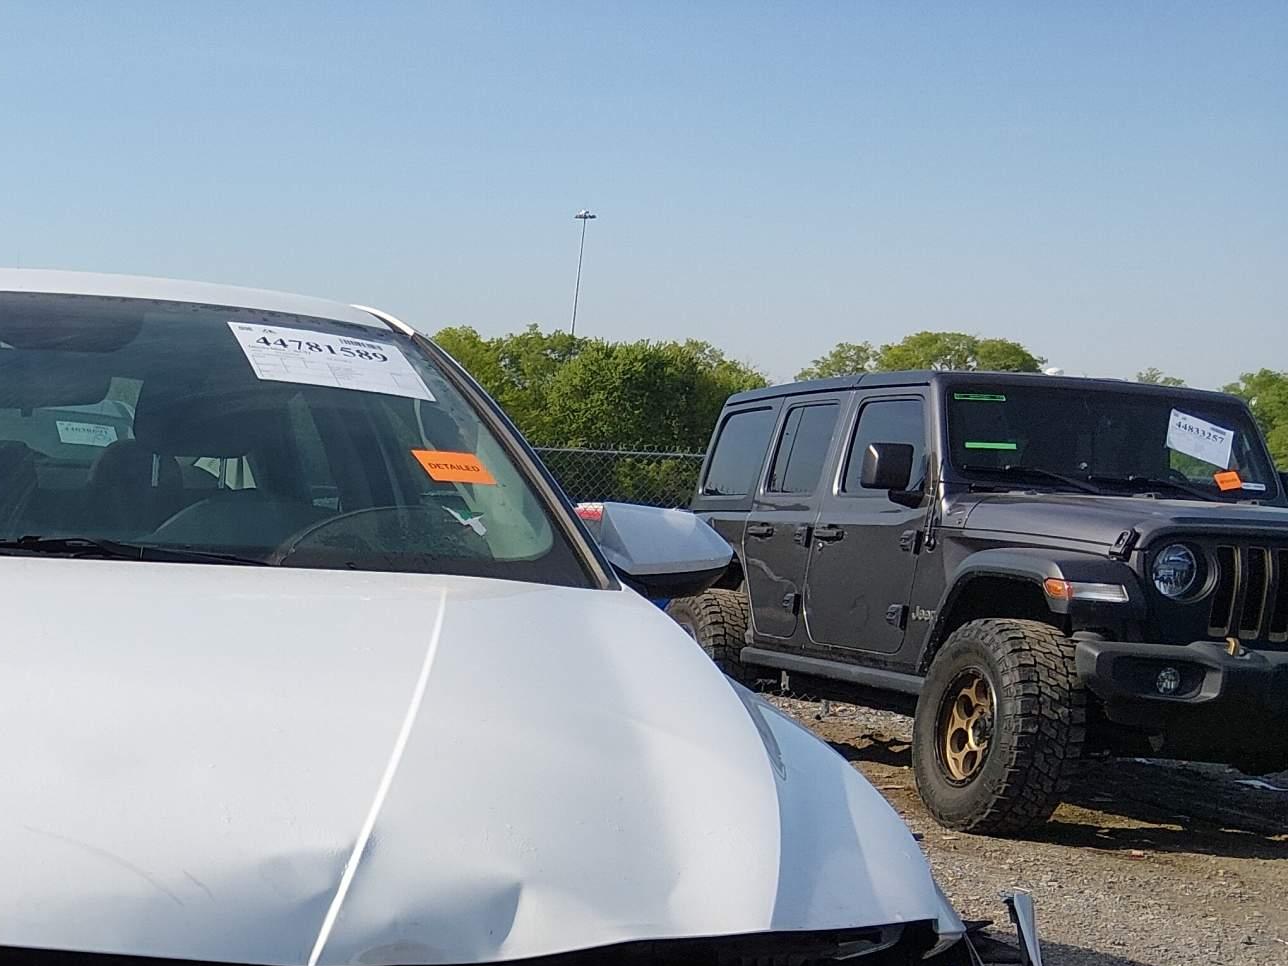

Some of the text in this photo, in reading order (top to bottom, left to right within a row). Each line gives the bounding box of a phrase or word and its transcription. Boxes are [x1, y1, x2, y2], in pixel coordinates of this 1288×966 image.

[256, 336, 388, 363] 44781589
[1175, 420, 1225, 444] 44833257
[428, 462, 480, 473] DETAILED
